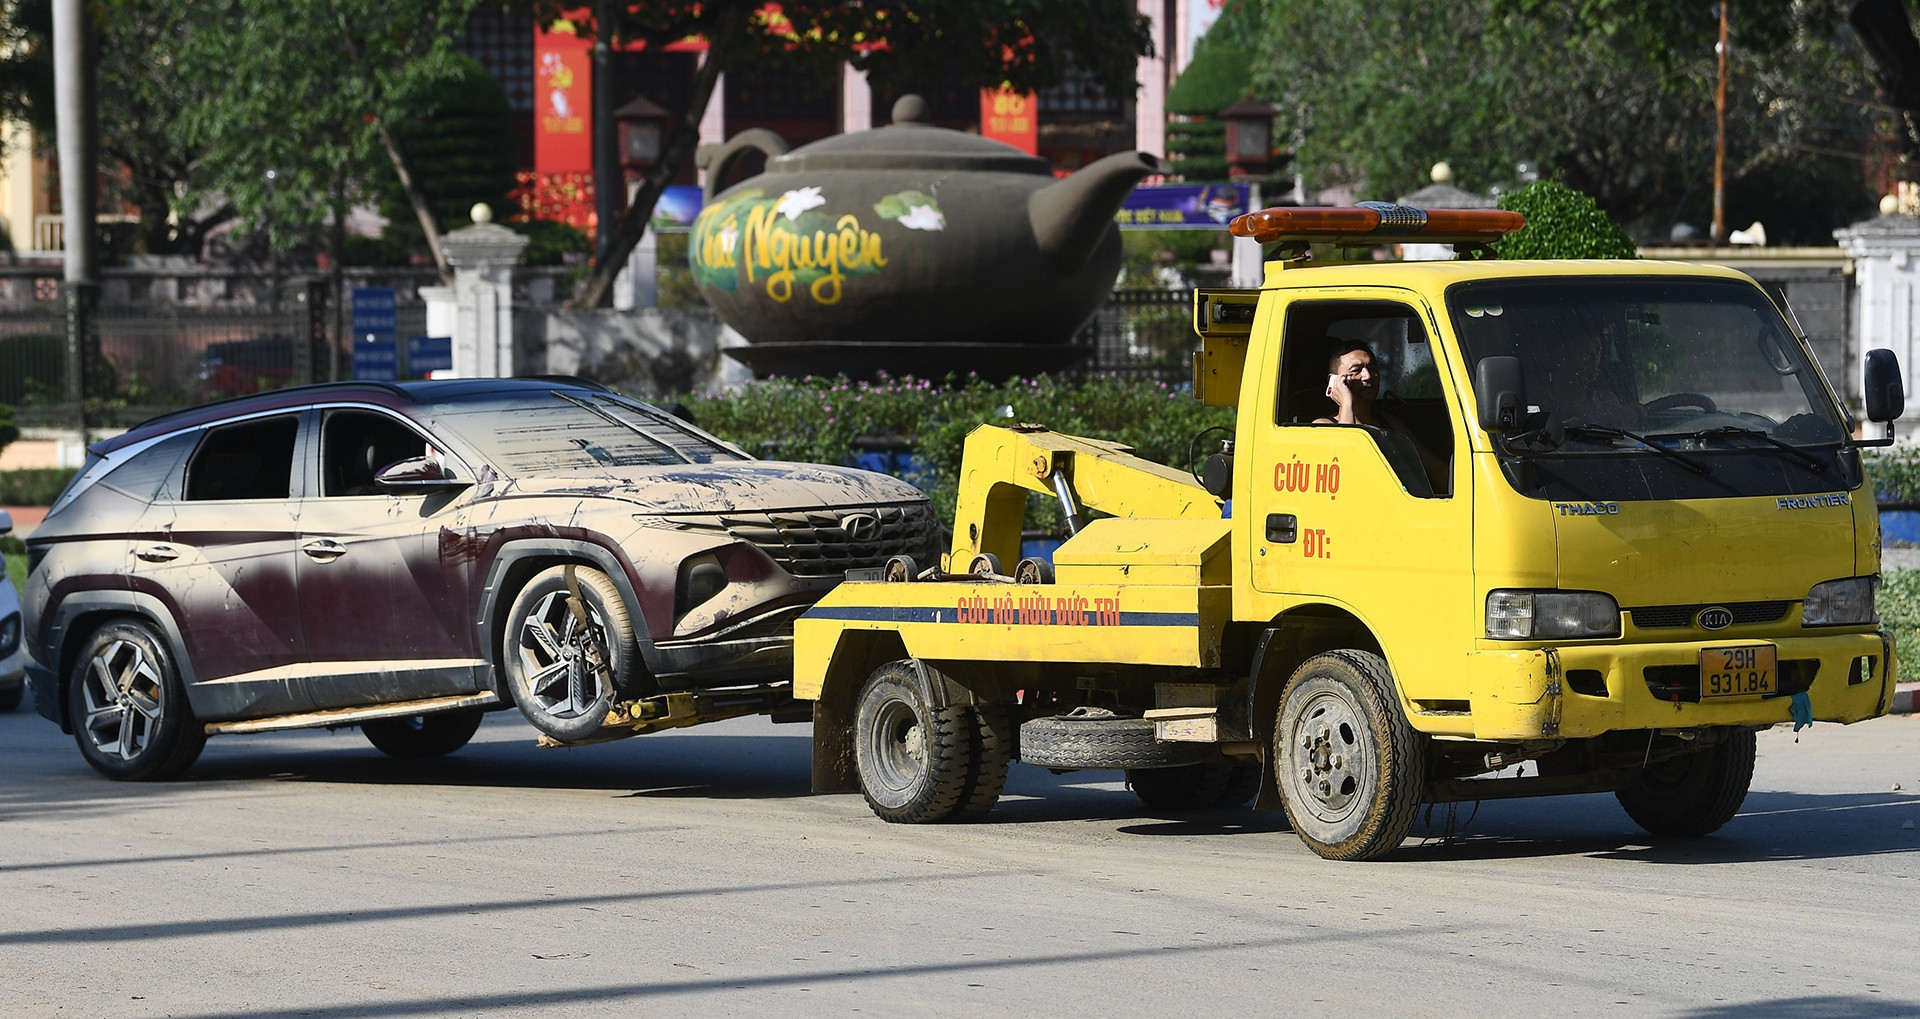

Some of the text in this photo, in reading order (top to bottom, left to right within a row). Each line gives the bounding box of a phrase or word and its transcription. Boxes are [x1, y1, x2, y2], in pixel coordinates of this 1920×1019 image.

[744, 194, 888, 304] Nguyên
[1273, 453, 1341, 500] CỨU HỘ
[1555, 503, 1620, 516] THACO
[1776, 494, 1849, 510] FRONTIER
[1303, 528, 1331, 559] ĐT:
[957, 586, 1121, 631] CỨU HỘ HỮU ĐỨC TRÍ
[1705, 613, 1728, 626] KIA
[1723, 648, 1756, 671] 29H
[1710, 671, 1769, 694] 931.84
